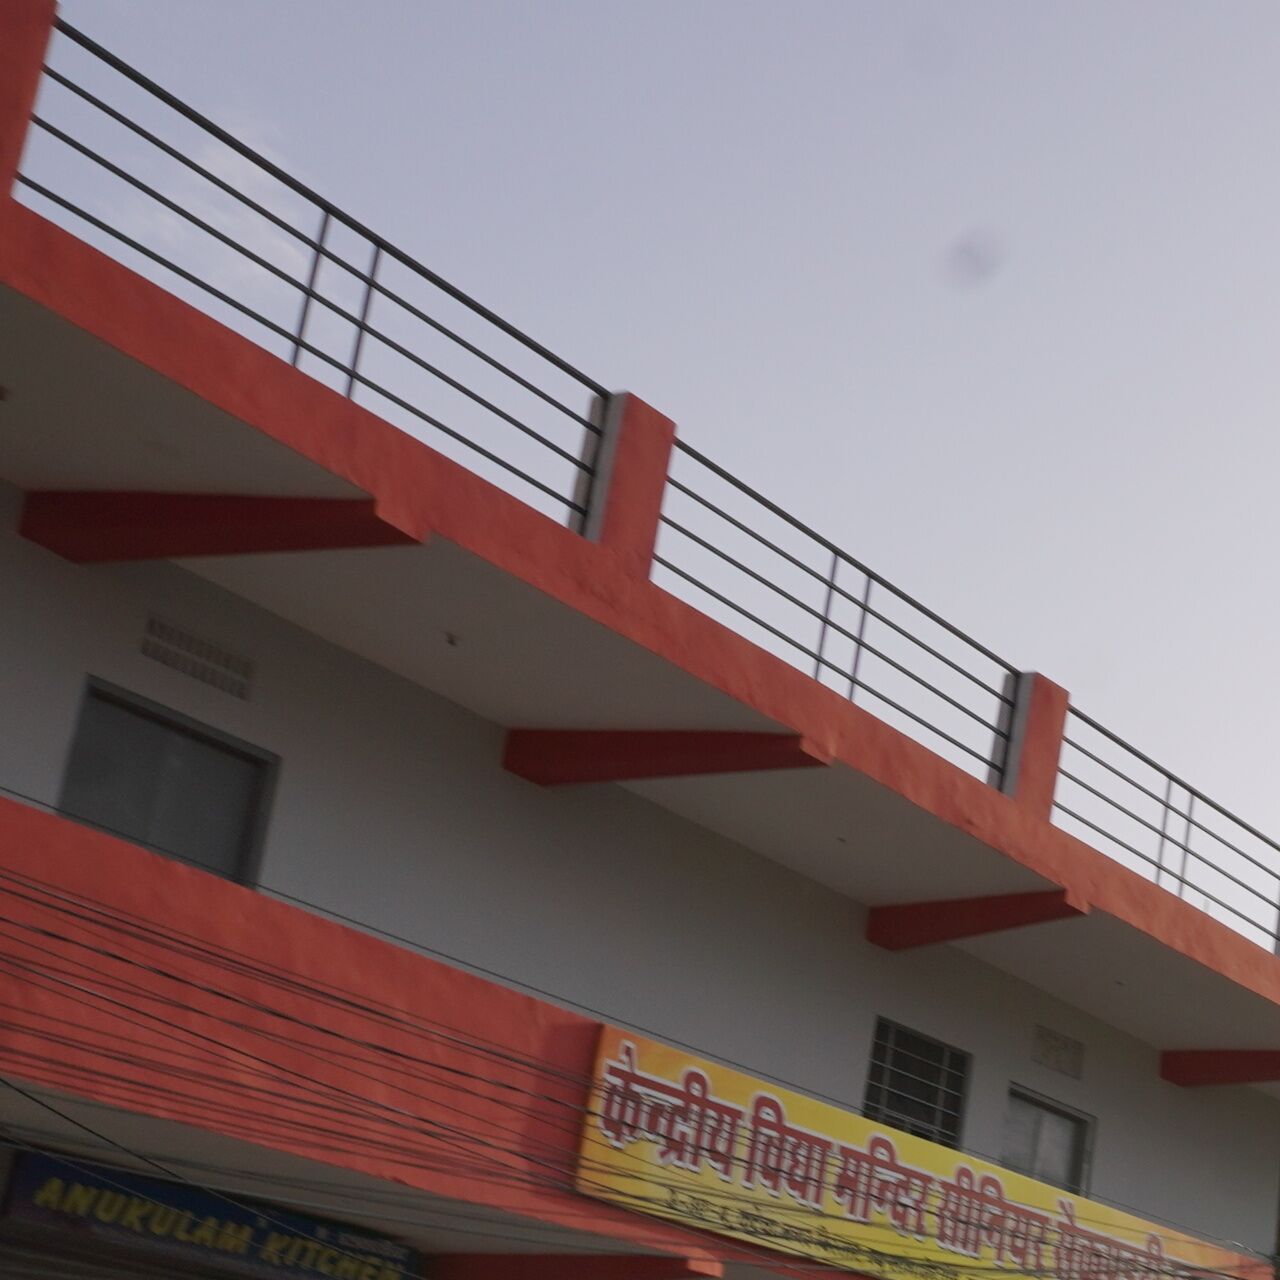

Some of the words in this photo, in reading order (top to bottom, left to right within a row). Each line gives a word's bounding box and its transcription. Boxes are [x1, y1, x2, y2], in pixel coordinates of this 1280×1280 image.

[33, 1176, 254, 1256] ANUKULAM
[597, 1039, 745, 1183] केन्द्रीय
[743, 1092, 833, 1210] विद्या
[935, 1164, 1050, 1274] सीनियर
